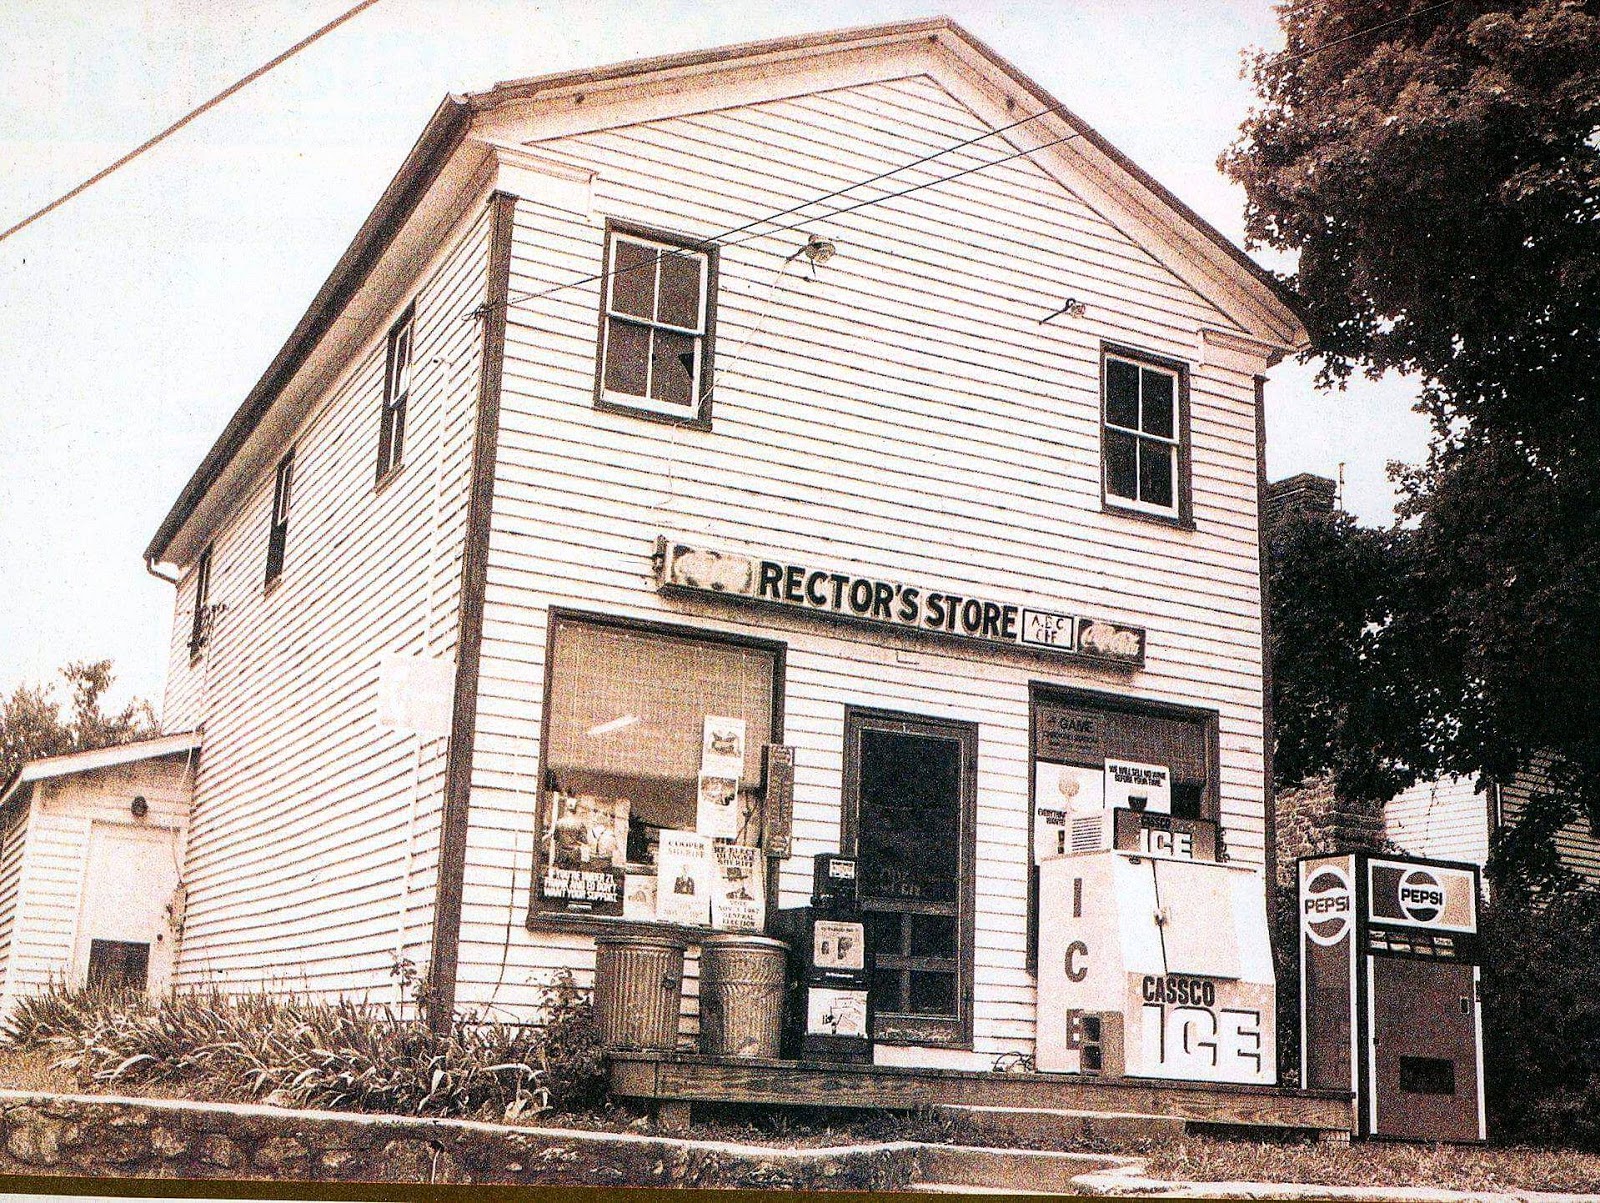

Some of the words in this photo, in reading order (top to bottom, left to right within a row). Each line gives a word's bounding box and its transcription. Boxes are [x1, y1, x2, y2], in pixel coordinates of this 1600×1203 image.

[760, 560, 919, 622] RECTOR'S
[924, 592, 1018, 639] STORE
[1140, 827, 1193, 859] ICE
[1304, 895, 1350, 915] PEPSI
[1401, 888, 1443, 906] PEPSI
[1142, 975, 1216, 1007] CASSCO
[1142, 1002, 1261, 1074] ICE
